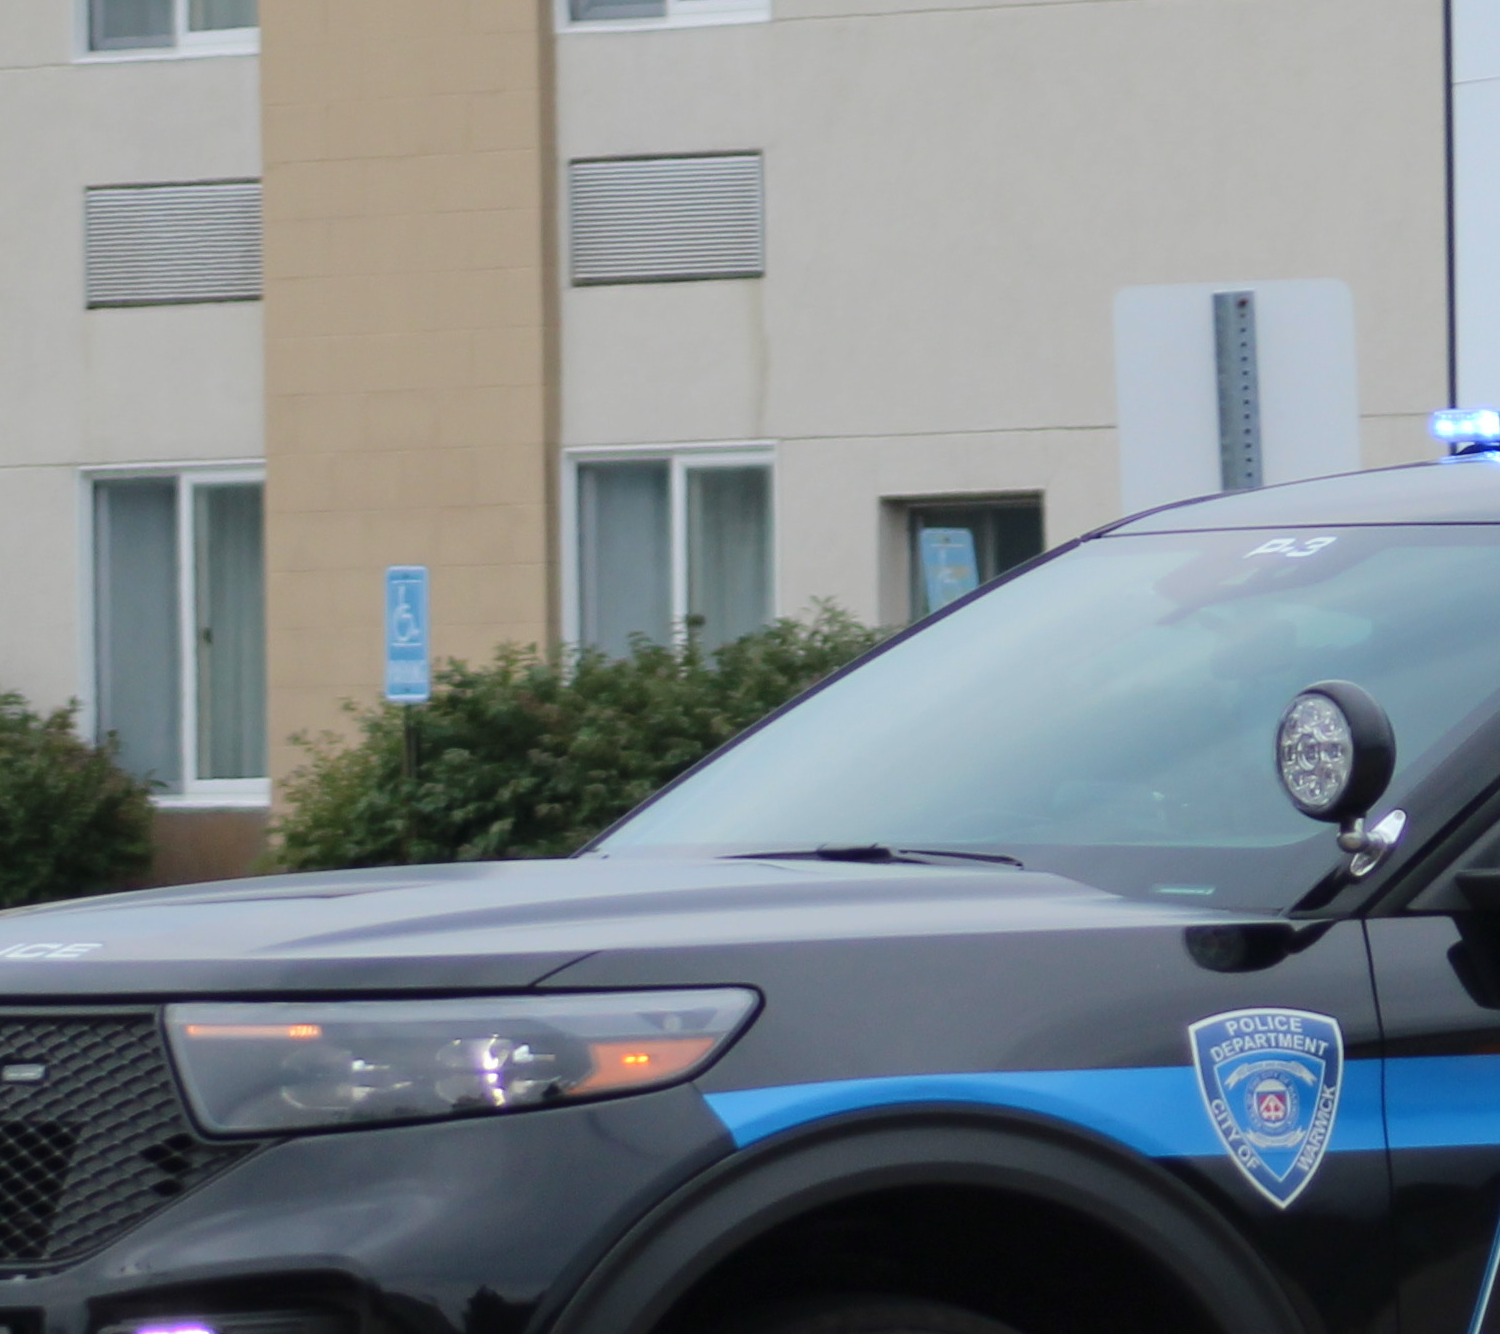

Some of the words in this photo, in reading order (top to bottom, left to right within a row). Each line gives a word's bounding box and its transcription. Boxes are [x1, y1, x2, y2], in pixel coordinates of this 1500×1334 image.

[1224, 1016, 1303, 1036] POLICE
[1209, 1032, 1329, 1062] DEPARTMENT
[1210, 1098, 1242, 1142] CITY
[1237, 1145, 1262, 1170] OF
[1296, 1083, 1337, 1171] WARWICK
